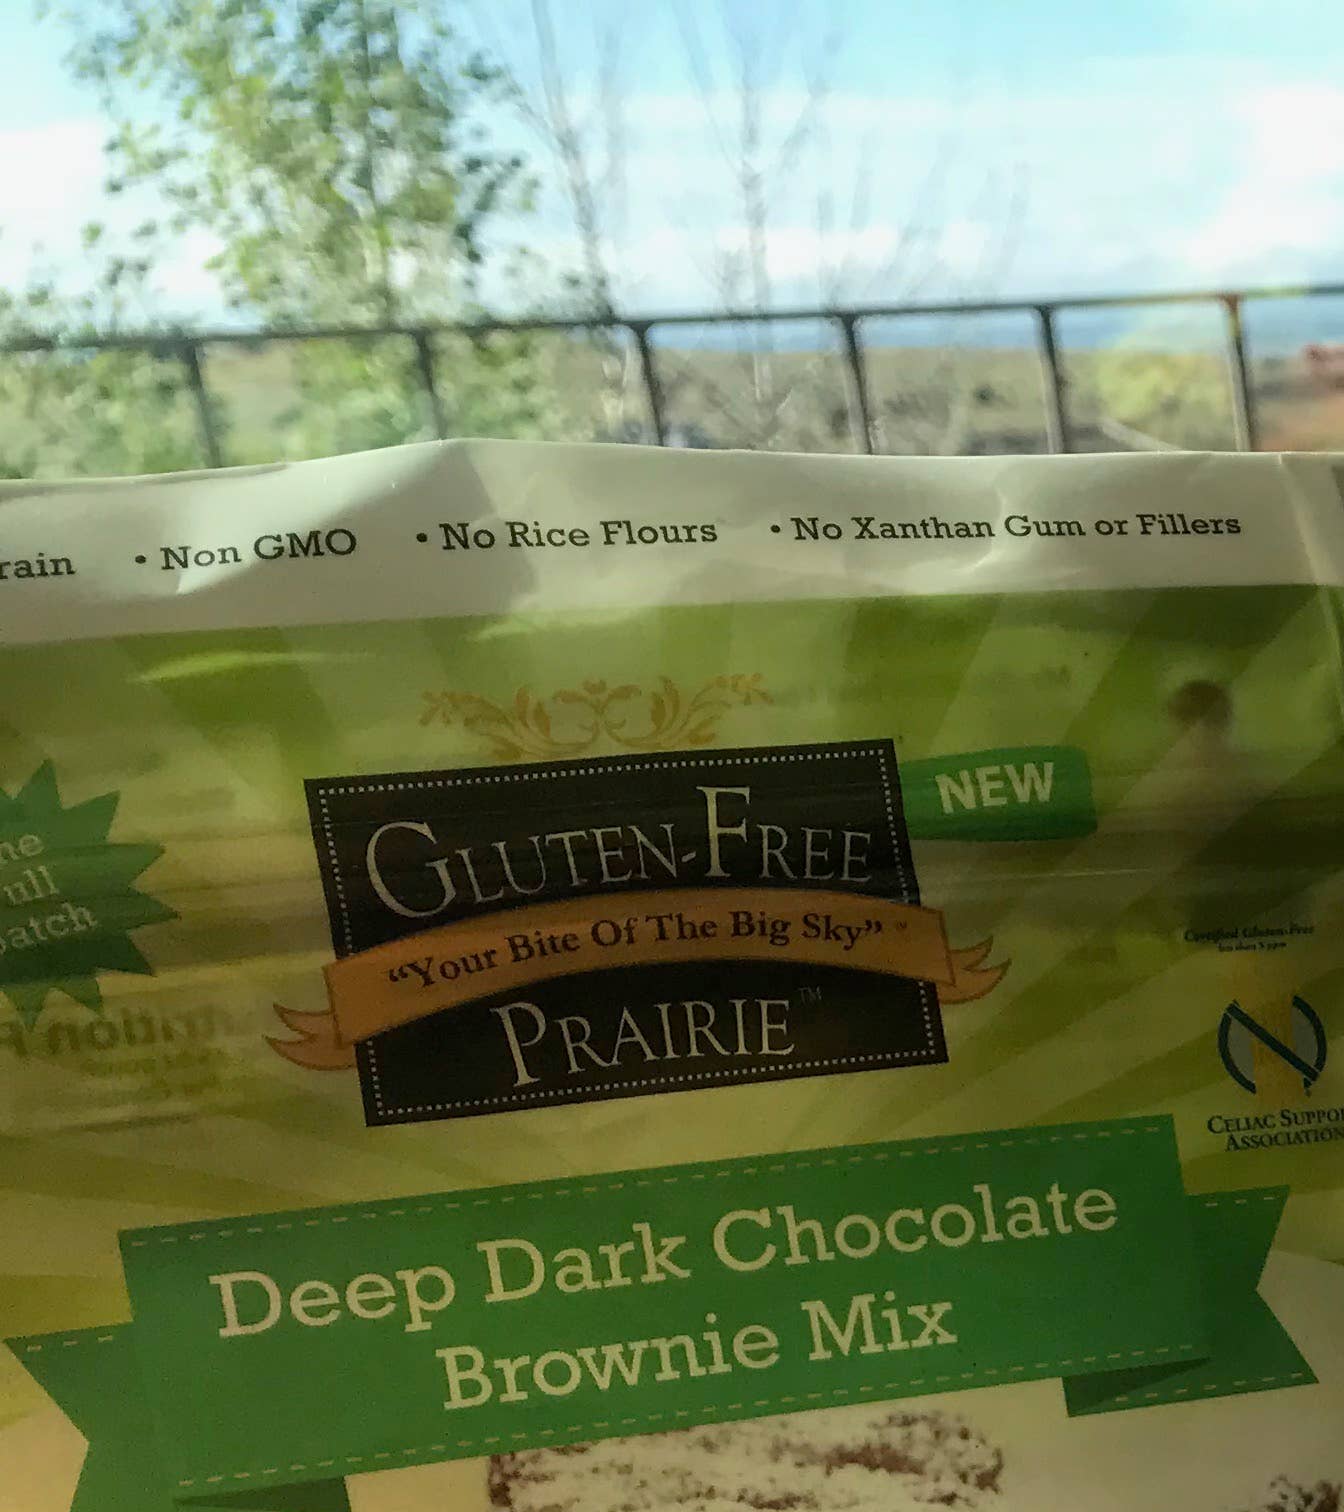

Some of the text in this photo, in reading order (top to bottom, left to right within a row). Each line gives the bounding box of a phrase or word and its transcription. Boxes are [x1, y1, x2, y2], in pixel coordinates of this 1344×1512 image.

[160, 546, 243, 571] Non
[254, 528, 358, 562] GMO
[439, 522, 496, 551] No
[506, 520, 591, 549] Rice
[598, 518, 720, 547] Flours
[791, 517, 843, 541] No
[853, 515, 996, 540] Xanthan
[1003, 514, 1086, 538] Gum
[1094, 518, 1130, 537] or
[1135, 513, 1242, 536] Fillers
[934, 762, 1056, 815] NEW
[505, 926, 581, 963] Bite
[590, 915, 638, 947] Of
[645, 910, 719, 942] The
[730, 908, 791, 947] Big
[488, 998, 796, 1088] PRAIRIE
[209, 1182, 1118, 1338] Deep Dark Chocolate
[436, 1293, 958, 1410] Brownie Mix
